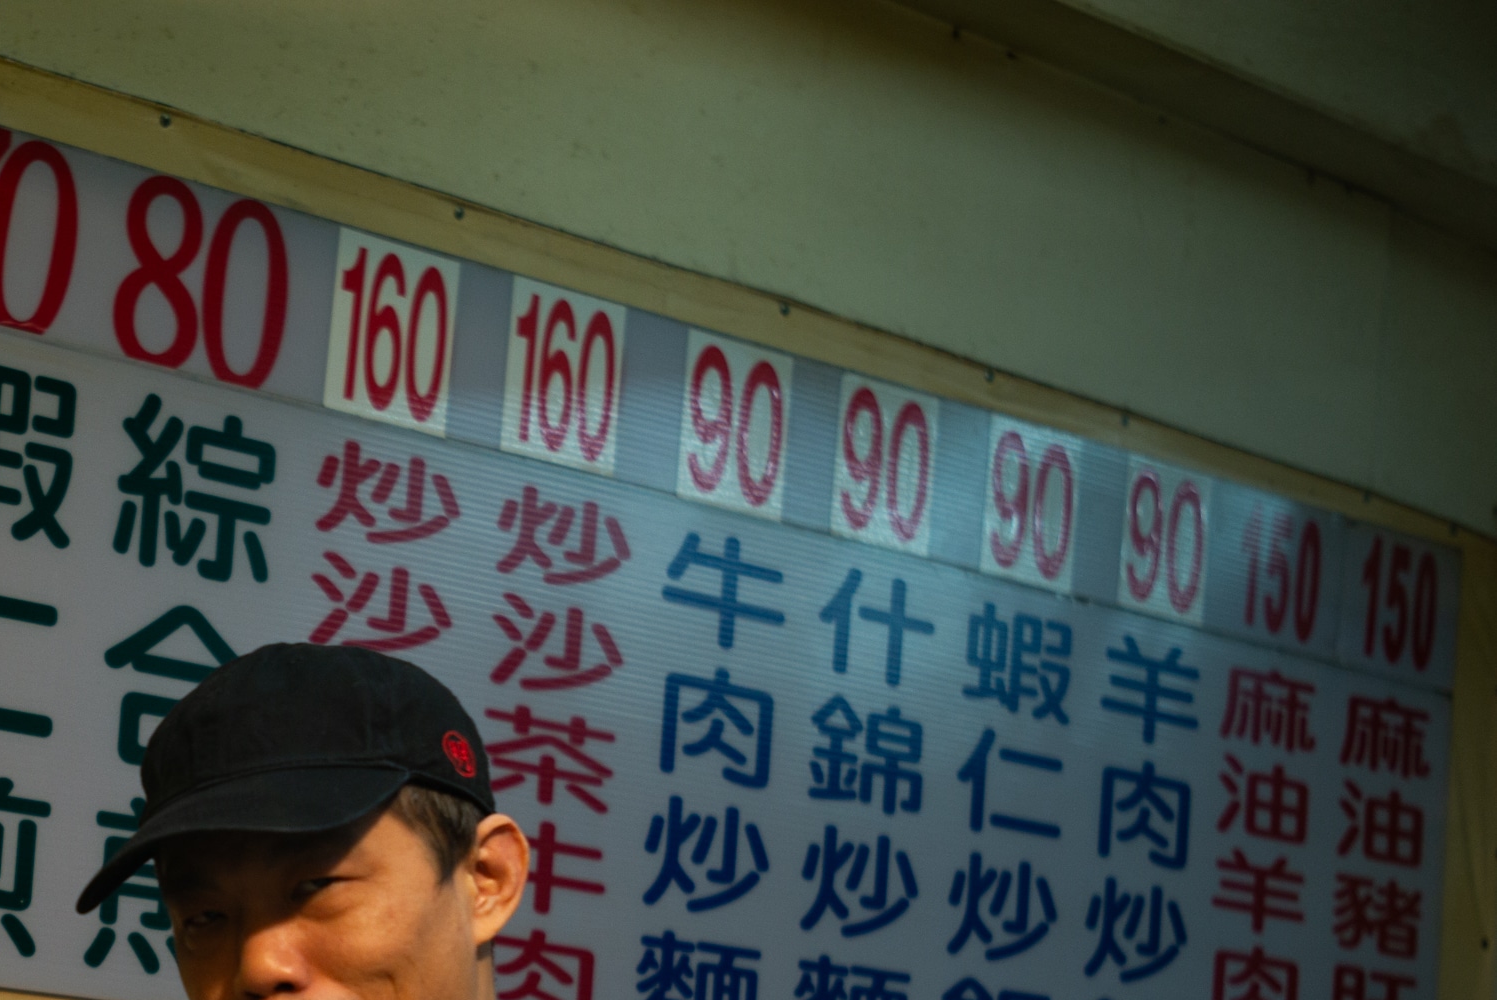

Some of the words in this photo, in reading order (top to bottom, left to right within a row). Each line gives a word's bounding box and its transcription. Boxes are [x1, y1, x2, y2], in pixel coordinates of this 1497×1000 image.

[113, 176, 288, 388] 80
[341, 247, 448, 422] 160
[516, 294, 615, 462] 160
[688, 344, 783, 507] 90
[841, 386, 929, 542] 90
[990, 431, 1074, 580] 90
[1126, 470, 1204, 615] 90
[1242, 504, 1322, 645] 150
[1362, 535, 1438, 672] 150
